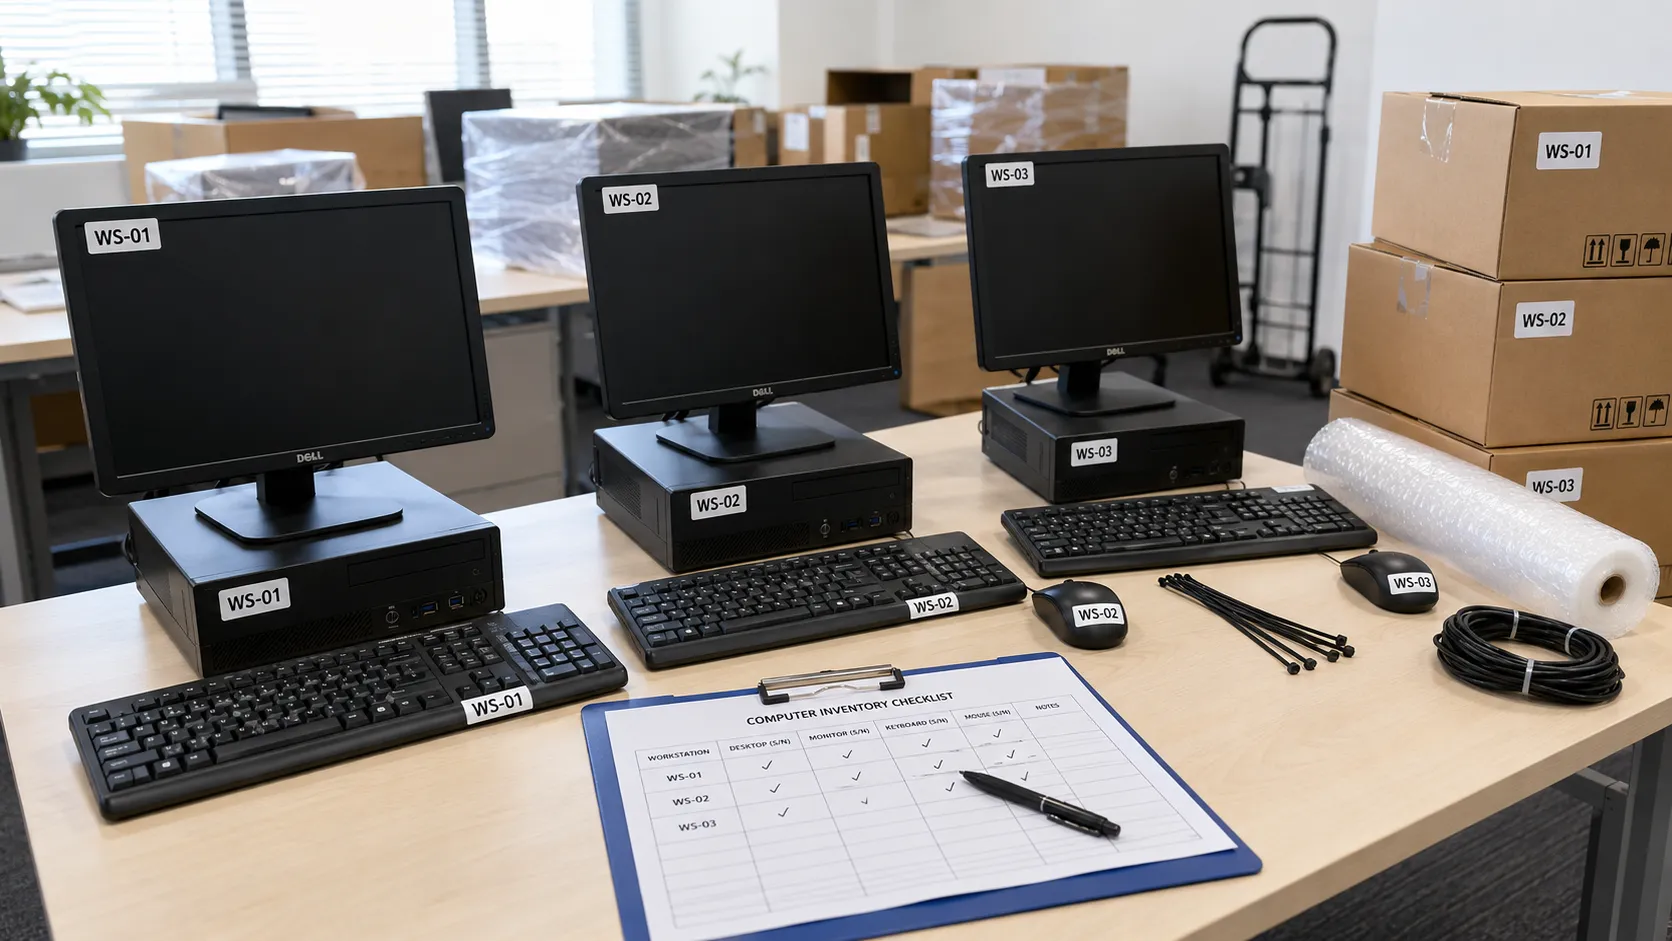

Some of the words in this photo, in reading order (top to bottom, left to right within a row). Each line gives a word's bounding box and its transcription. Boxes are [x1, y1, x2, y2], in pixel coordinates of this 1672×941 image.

[1545, 143, 1591, 159] WS-01
[990, 166, 1029, 182] WS-03
[608, 191, 653, 208] WS-02
[94, 228, 151, 247] WS-01
[1522, 312, 1567, 328] WS-02
[1106, 347, 1126, 356] DELL
[752, 387, 774, 397] DELL
[296, 451, 324, 463] DELL
[1075, 444, 1113, 461] WS-03
[1533, 479, 1575, 495] WS-03
[696, 493, 741, 513] WS-02
[1393, 576, 1432, 590] WS-03
[227, 588, 281, 612] WS-01
[914, 597, 954, 614] WS-02
[1078, 608, 1119, 622] WS-02
[471, 693, 523, 719] WS-01
[746, 709, 818, 726] COMPUTER
[819, 700, 889, 717] INVENTORY
[891, 692, 954, 708] CHECKLIST
[1035, 702, 1060, 711] NOTES
[964, 711, 991, 721] MOUSE
[885, 720, 928, 731] KEYBOARD
[808, 731, 848, 741] MONITOR
[729, 741, 767, 752] DESKTOP
[647, 748, 710, 762] WORKSTATION
[666, 771, 702, 782] WS-01
[672, 795, 710, 806] WS-02
[678, 819, 717, 832] WS-03
